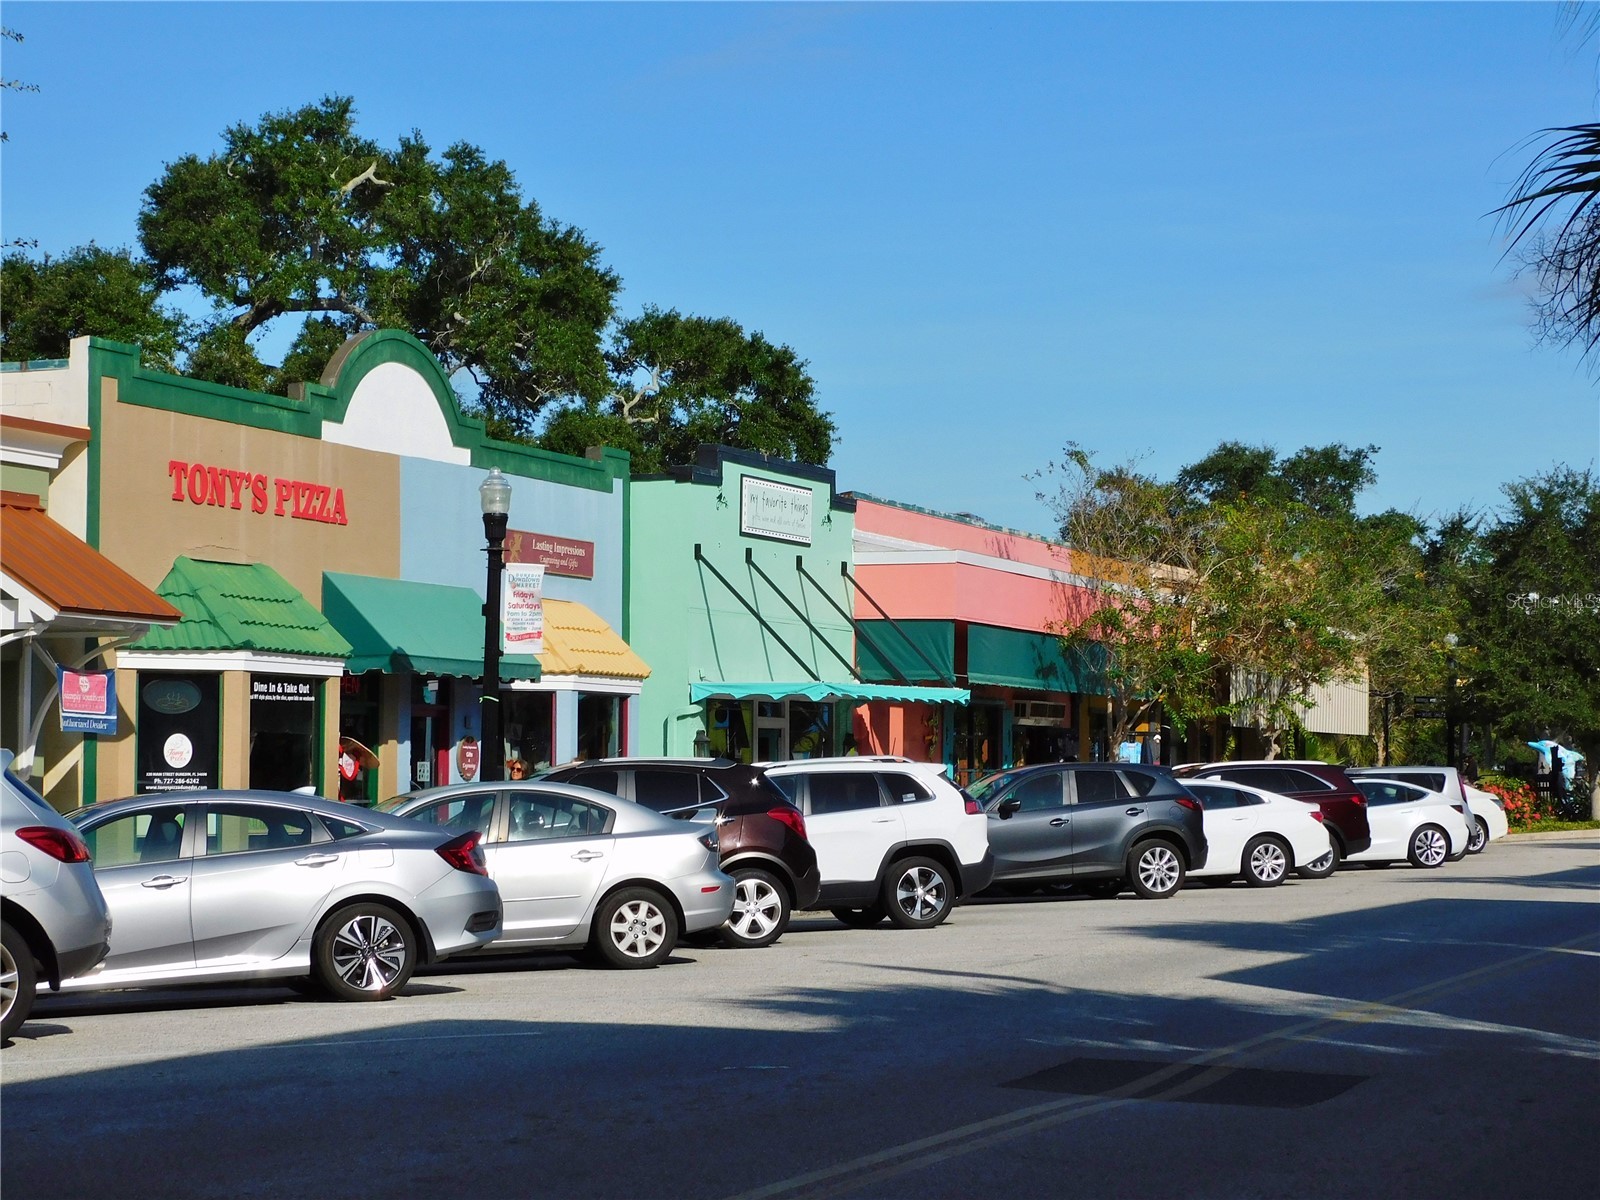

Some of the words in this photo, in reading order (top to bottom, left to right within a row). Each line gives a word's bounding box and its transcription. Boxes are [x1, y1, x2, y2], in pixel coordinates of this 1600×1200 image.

[168, 460, 268, 514] TONY'S
[274, 478, 348, 526] PIZZA
[762, 490, 787, 512] favorite
[790, 494, 809, 522] things
[532, 538, 554, 554] Lasting
[554, 542, 586, 556] Impressions
[539, 554, 560, 568] Engraving
[568, 558, 579, 570] Gifts
[508, 574, 540, 583] Downtown
[512, 590, 534, 600] Fridays
[508, 602, 540, 610] Saturdays
[254, 682, 268, 692] Dine
[268, 682, 276, 693] In
[277, 682, 282, 693] &
[283, 683, 298, 694] Take
[298, 684, 310, 694] Out
[62, 718, 90, 728] uthorized
[90, 720, 108, 730] Dealer
